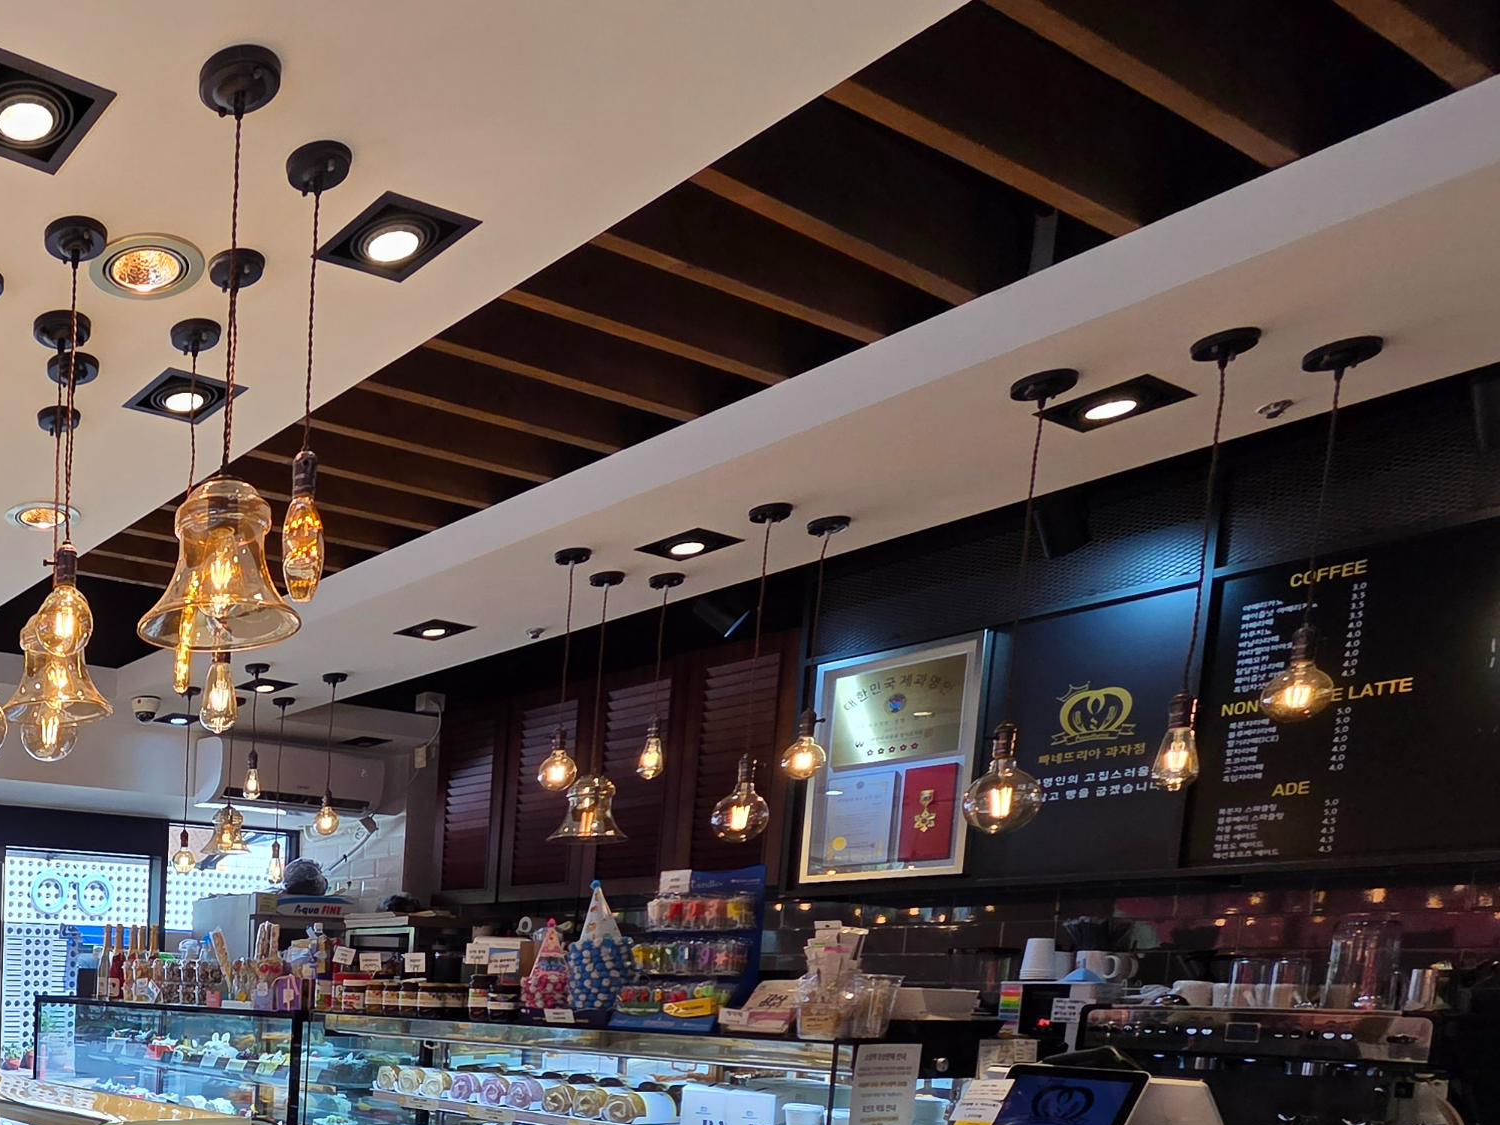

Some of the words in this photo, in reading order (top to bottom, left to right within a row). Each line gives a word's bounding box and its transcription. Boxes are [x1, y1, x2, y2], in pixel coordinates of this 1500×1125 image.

[1290, 559, 1369, 588] COFFEE
[1348, 676, 1414, 700] LATTE
[1271, 780, 1311, 797] ADE
[294, 904, 319, 915] Aqua
[321, 904, 342, 915] FINE
